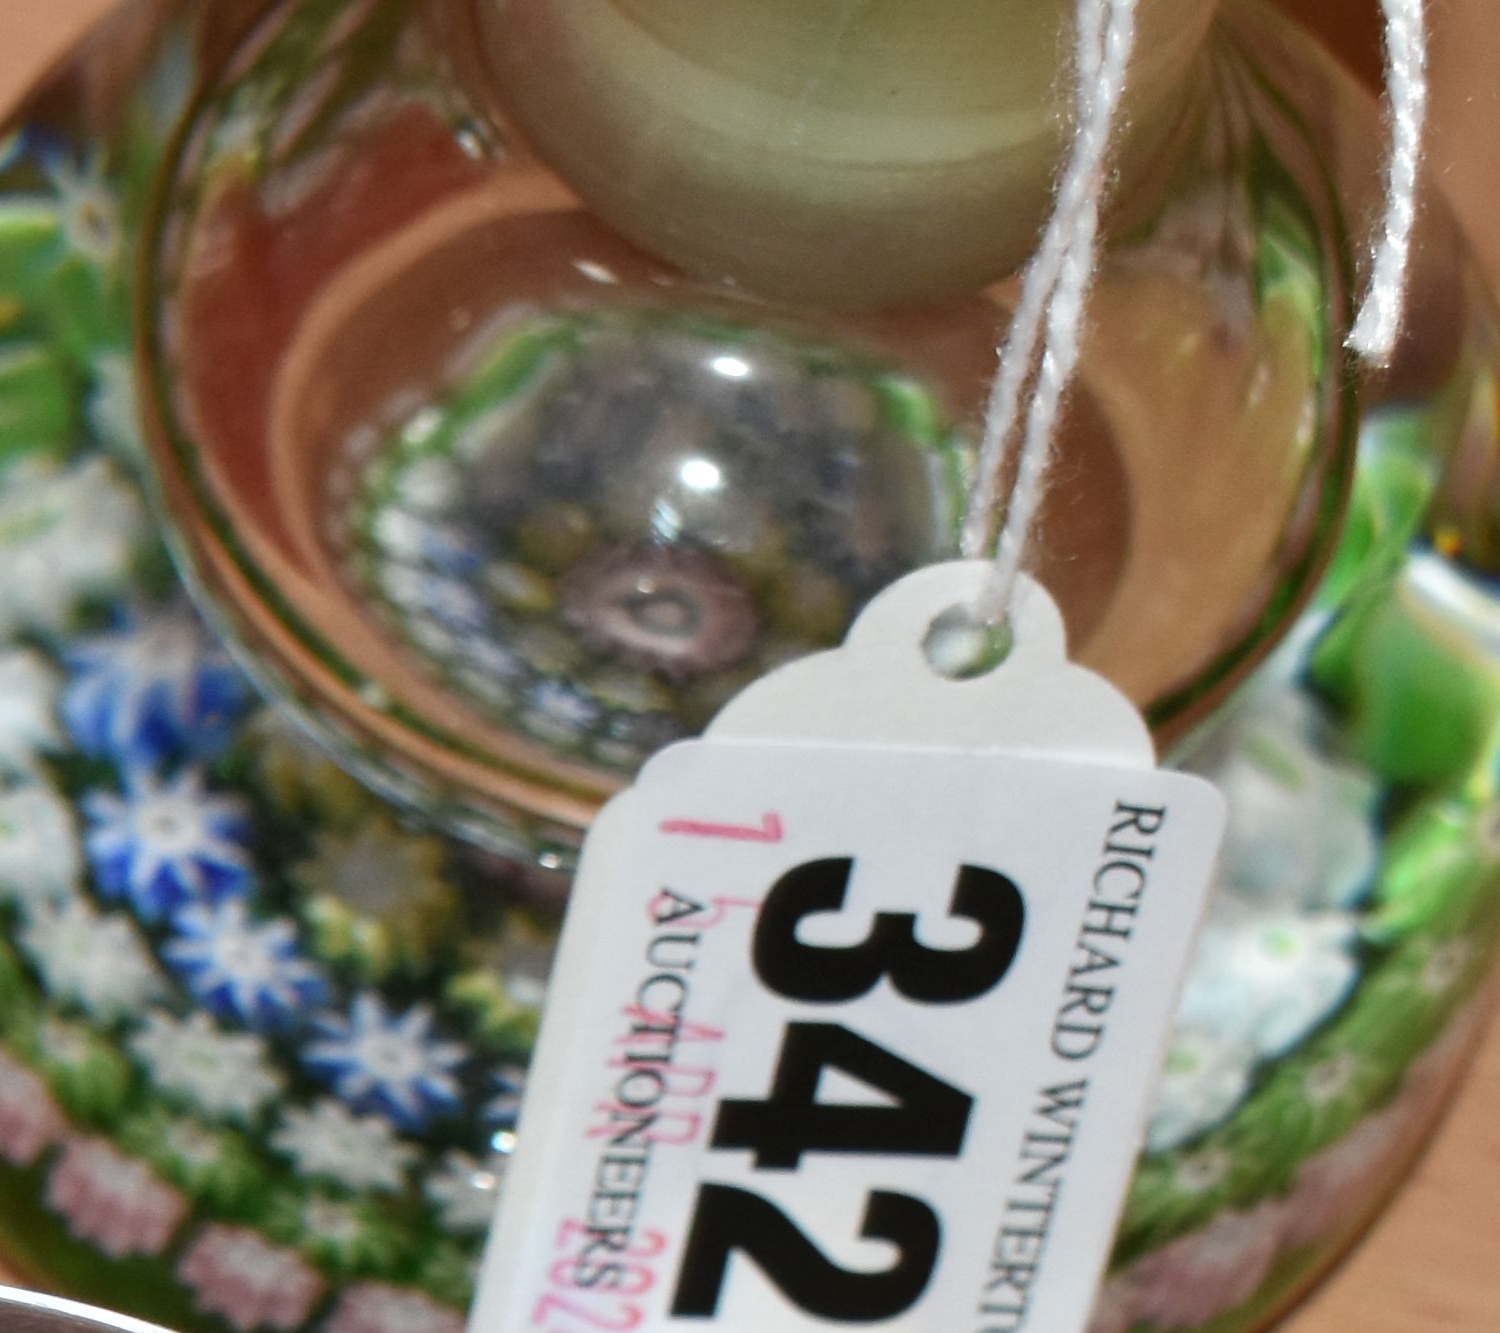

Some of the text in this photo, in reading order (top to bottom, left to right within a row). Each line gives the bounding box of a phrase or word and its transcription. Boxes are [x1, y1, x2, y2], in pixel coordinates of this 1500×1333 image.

[572, 887, 704, 1291] AUCTIONEERS
[586, 1003, 727, 1147] APR
[668, 856, 1027, 1324] 342
[1049, 799, 1168, 1062] RICHARD
